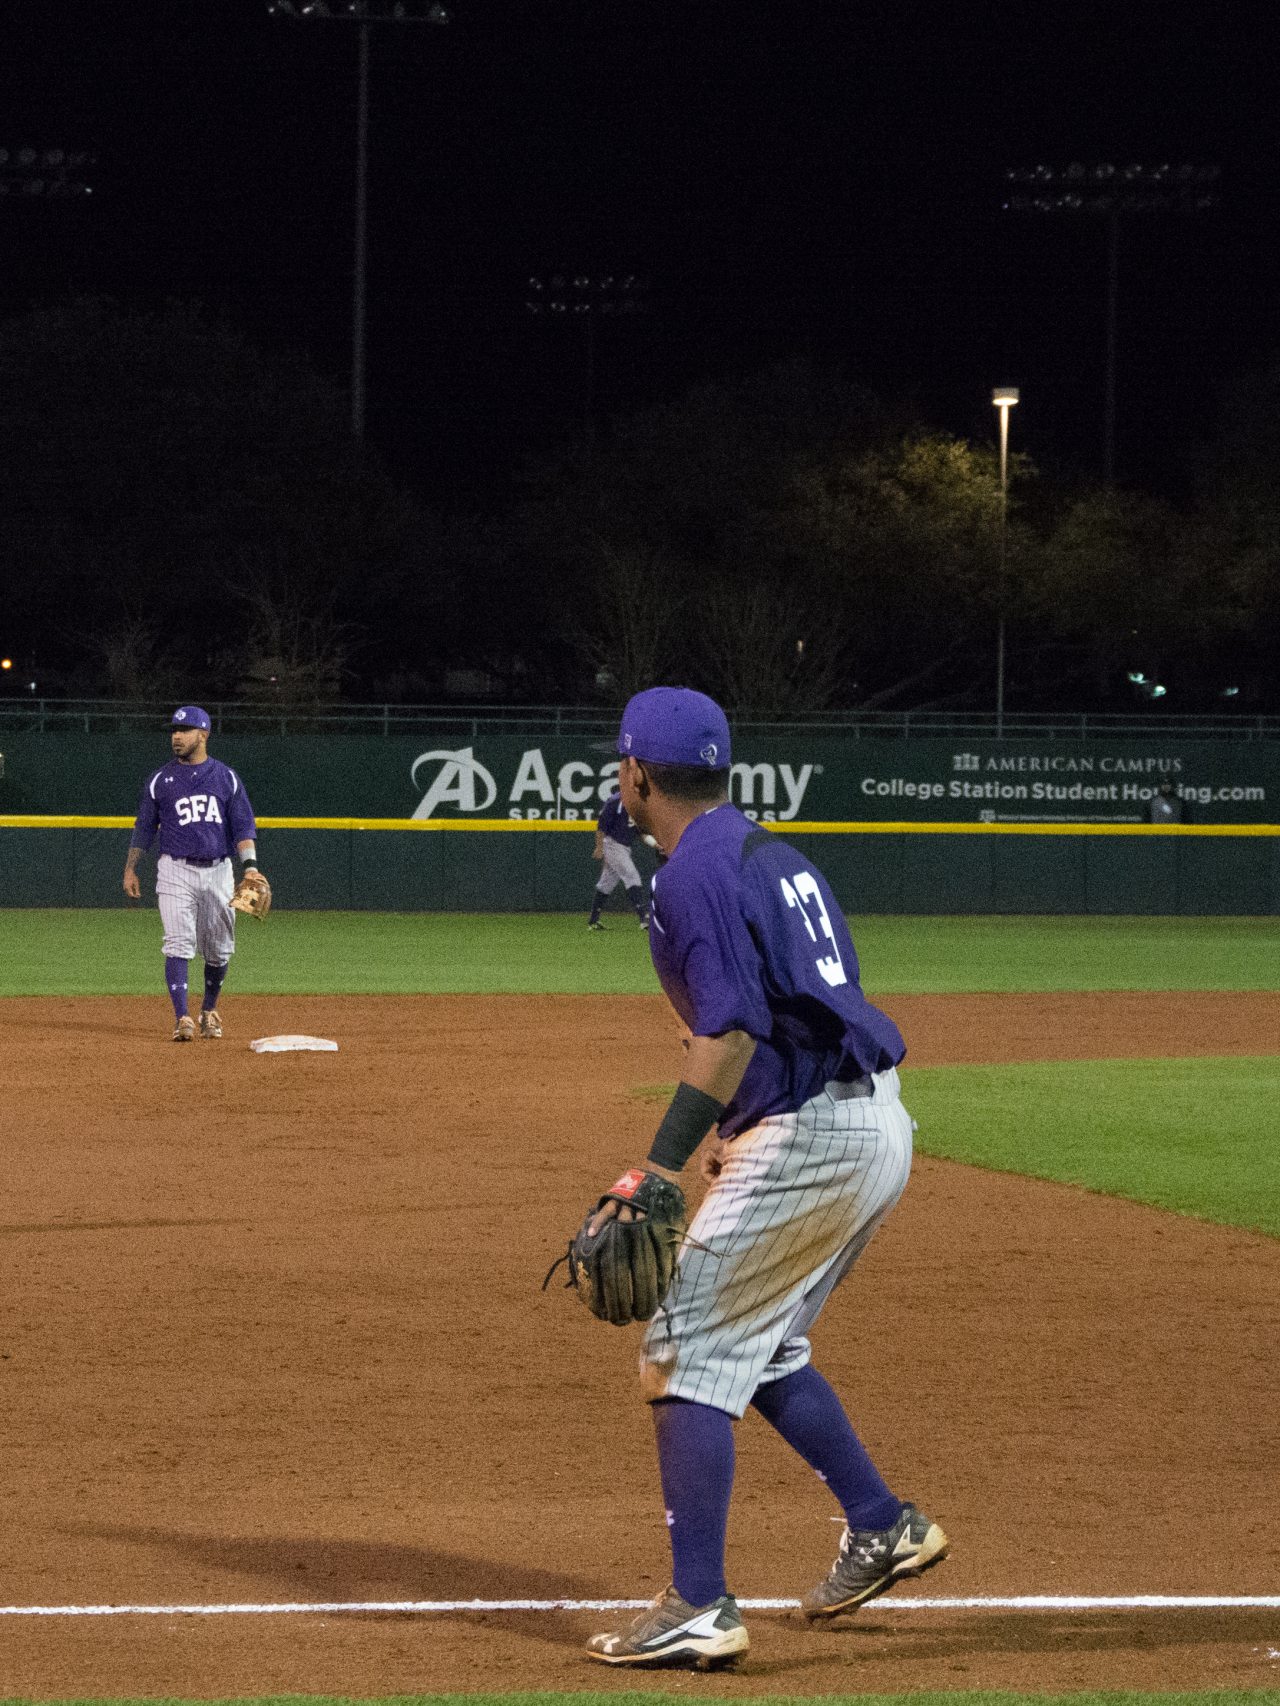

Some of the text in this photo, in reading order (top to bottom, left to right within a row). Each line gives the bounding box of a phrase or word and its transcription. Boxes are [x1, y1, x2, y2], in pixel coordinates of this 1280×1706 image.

[986, 757, 1183, 772] AMERICAN CAMPUS
[861, 778, 1265, 804] College Station Student Hoing.com
[175, 795, 222, 826] SFA
